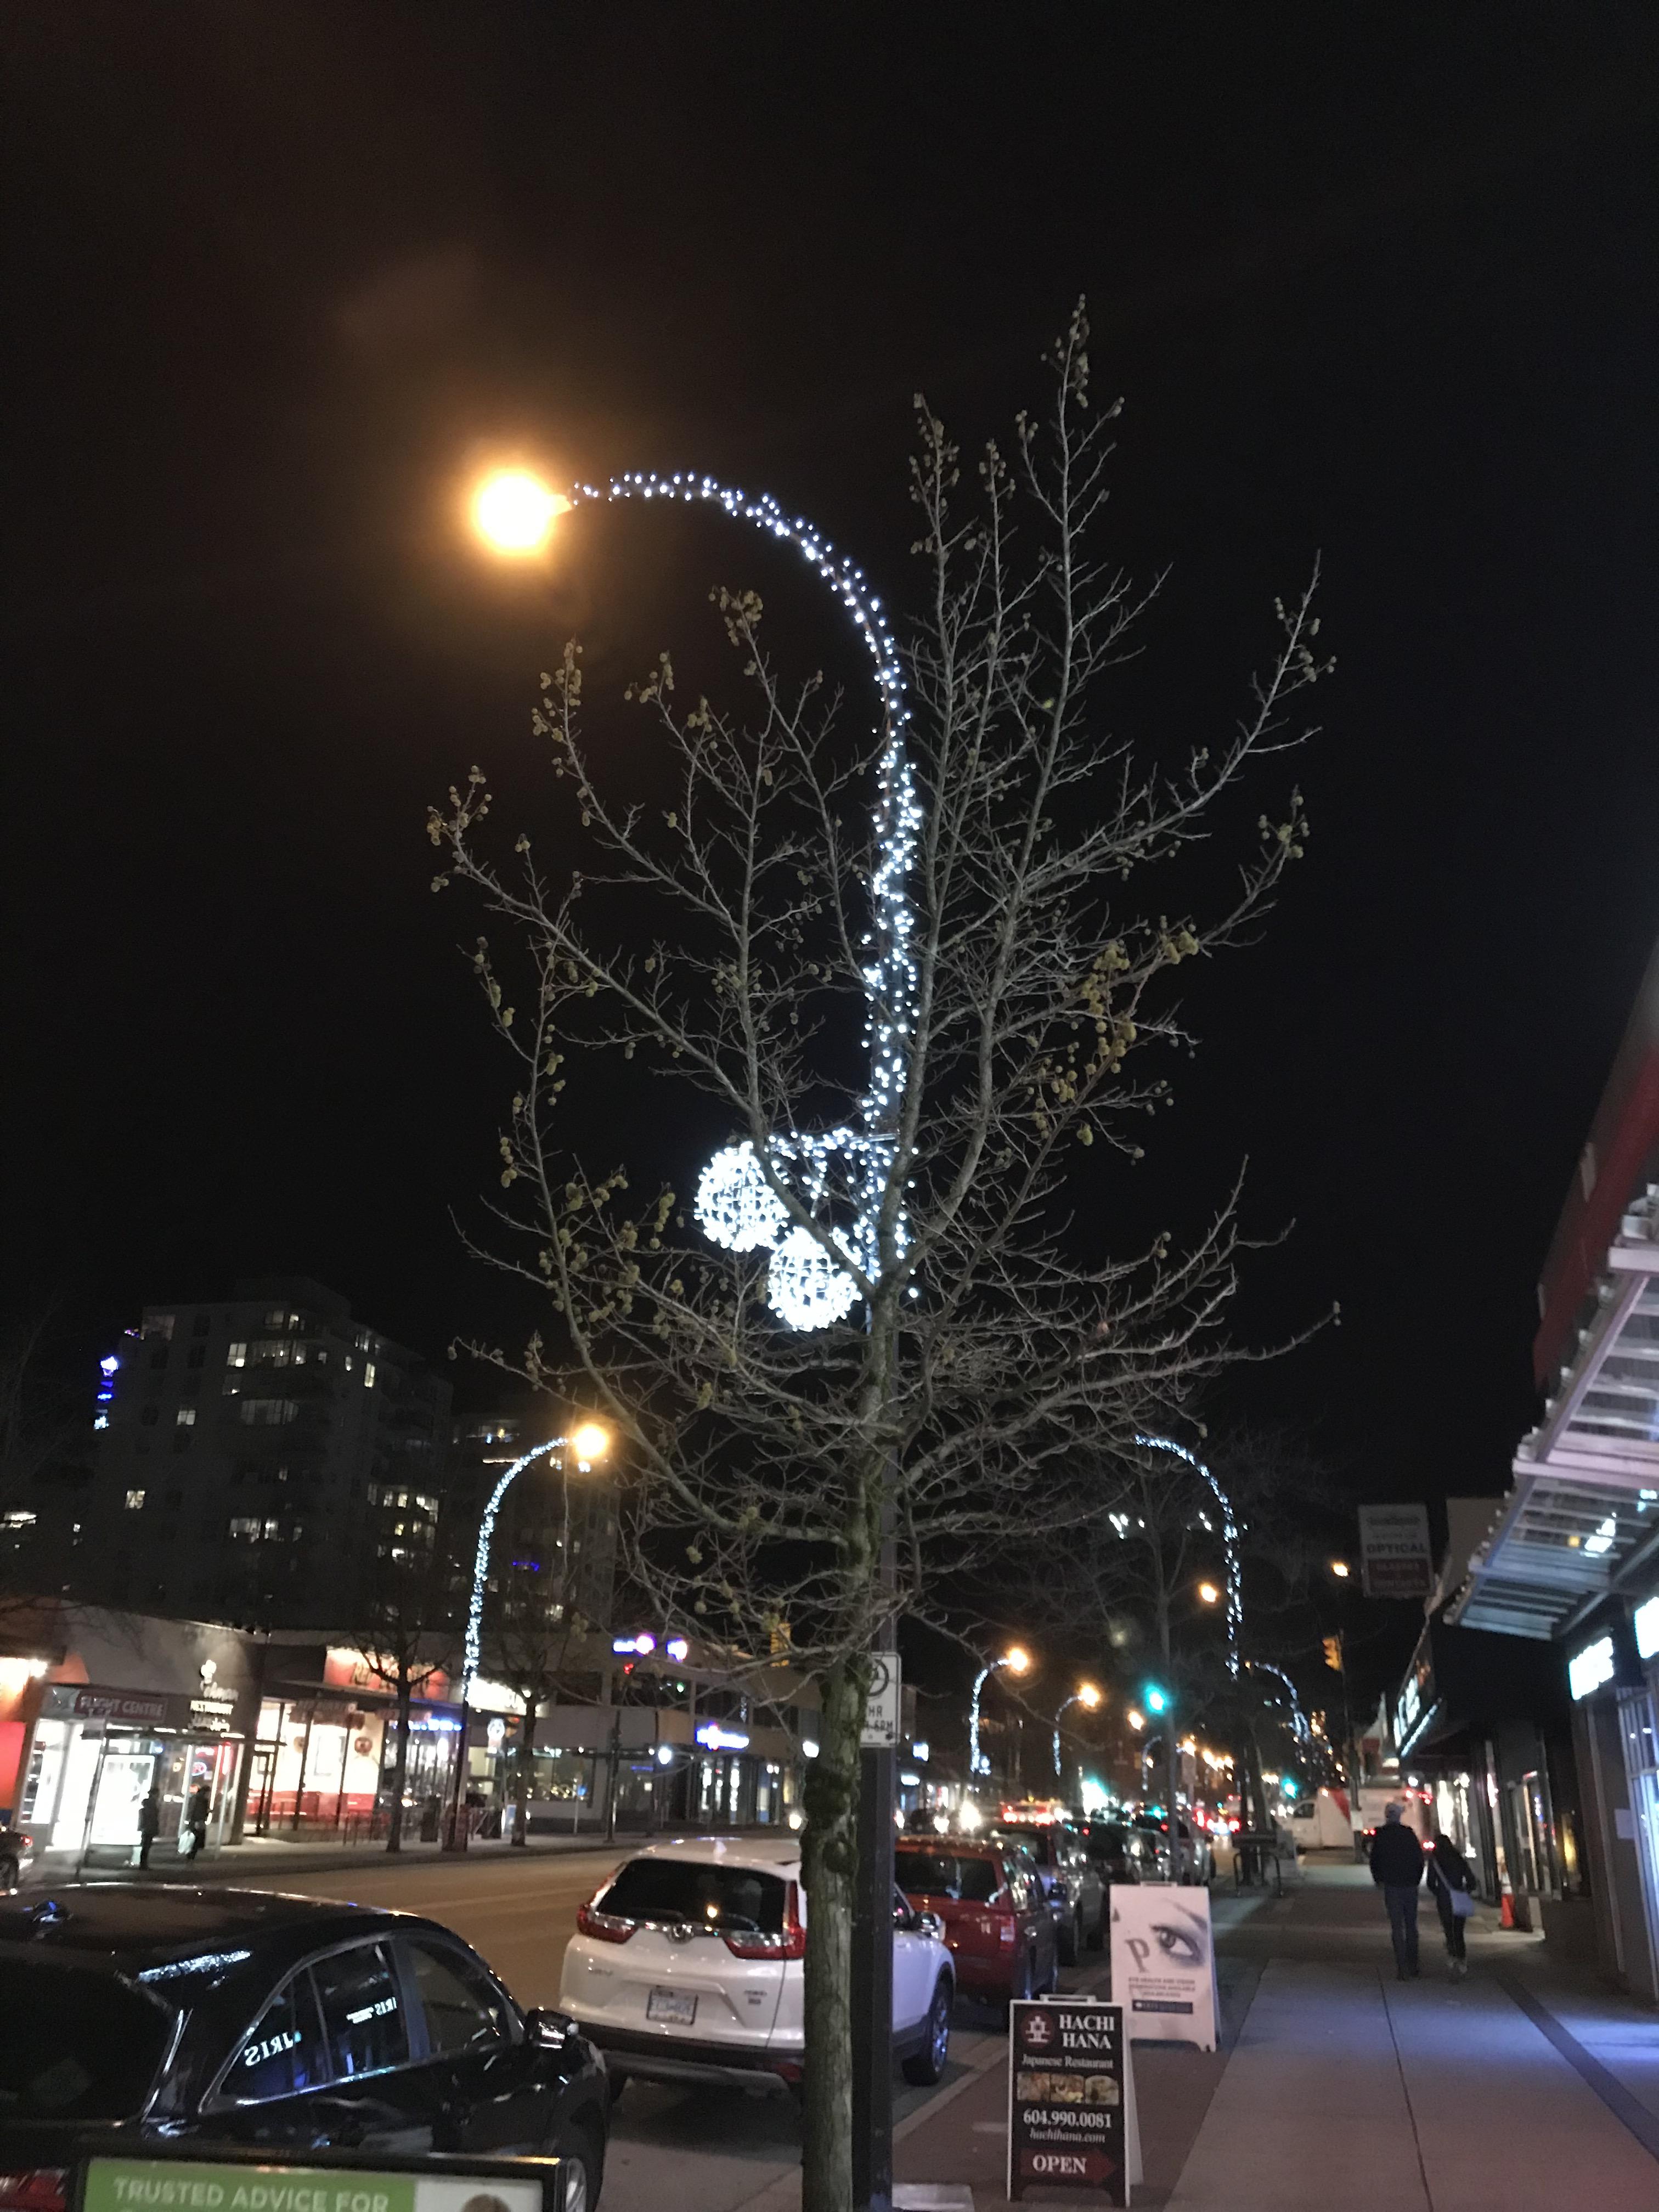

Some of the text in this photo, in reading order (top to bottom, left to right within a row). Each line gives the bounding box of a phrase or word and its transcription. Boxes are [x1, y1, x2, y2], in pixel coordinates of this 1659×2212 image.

[1366, 1542, 1427, 1554] OPTICAL
[122, 1700, 164, 1717] CENTRE
[868, 1705, 883, 1717] HR
[1059, 2014, 1114, 2032] HACHI
[1062, 2032, 1112, 2049] HANA
[1022, 2053, 1113, 2069] Japanese Restaurant
[1023, 2108, 1112, 2129] 604.990.0081
[1030, 2127, 1105, 2143] hachihana.com
[1032, 2155, 1087, 2174] OPEN
[113, 2176, 389, 2212] TRUSTED ADVICE FOR
